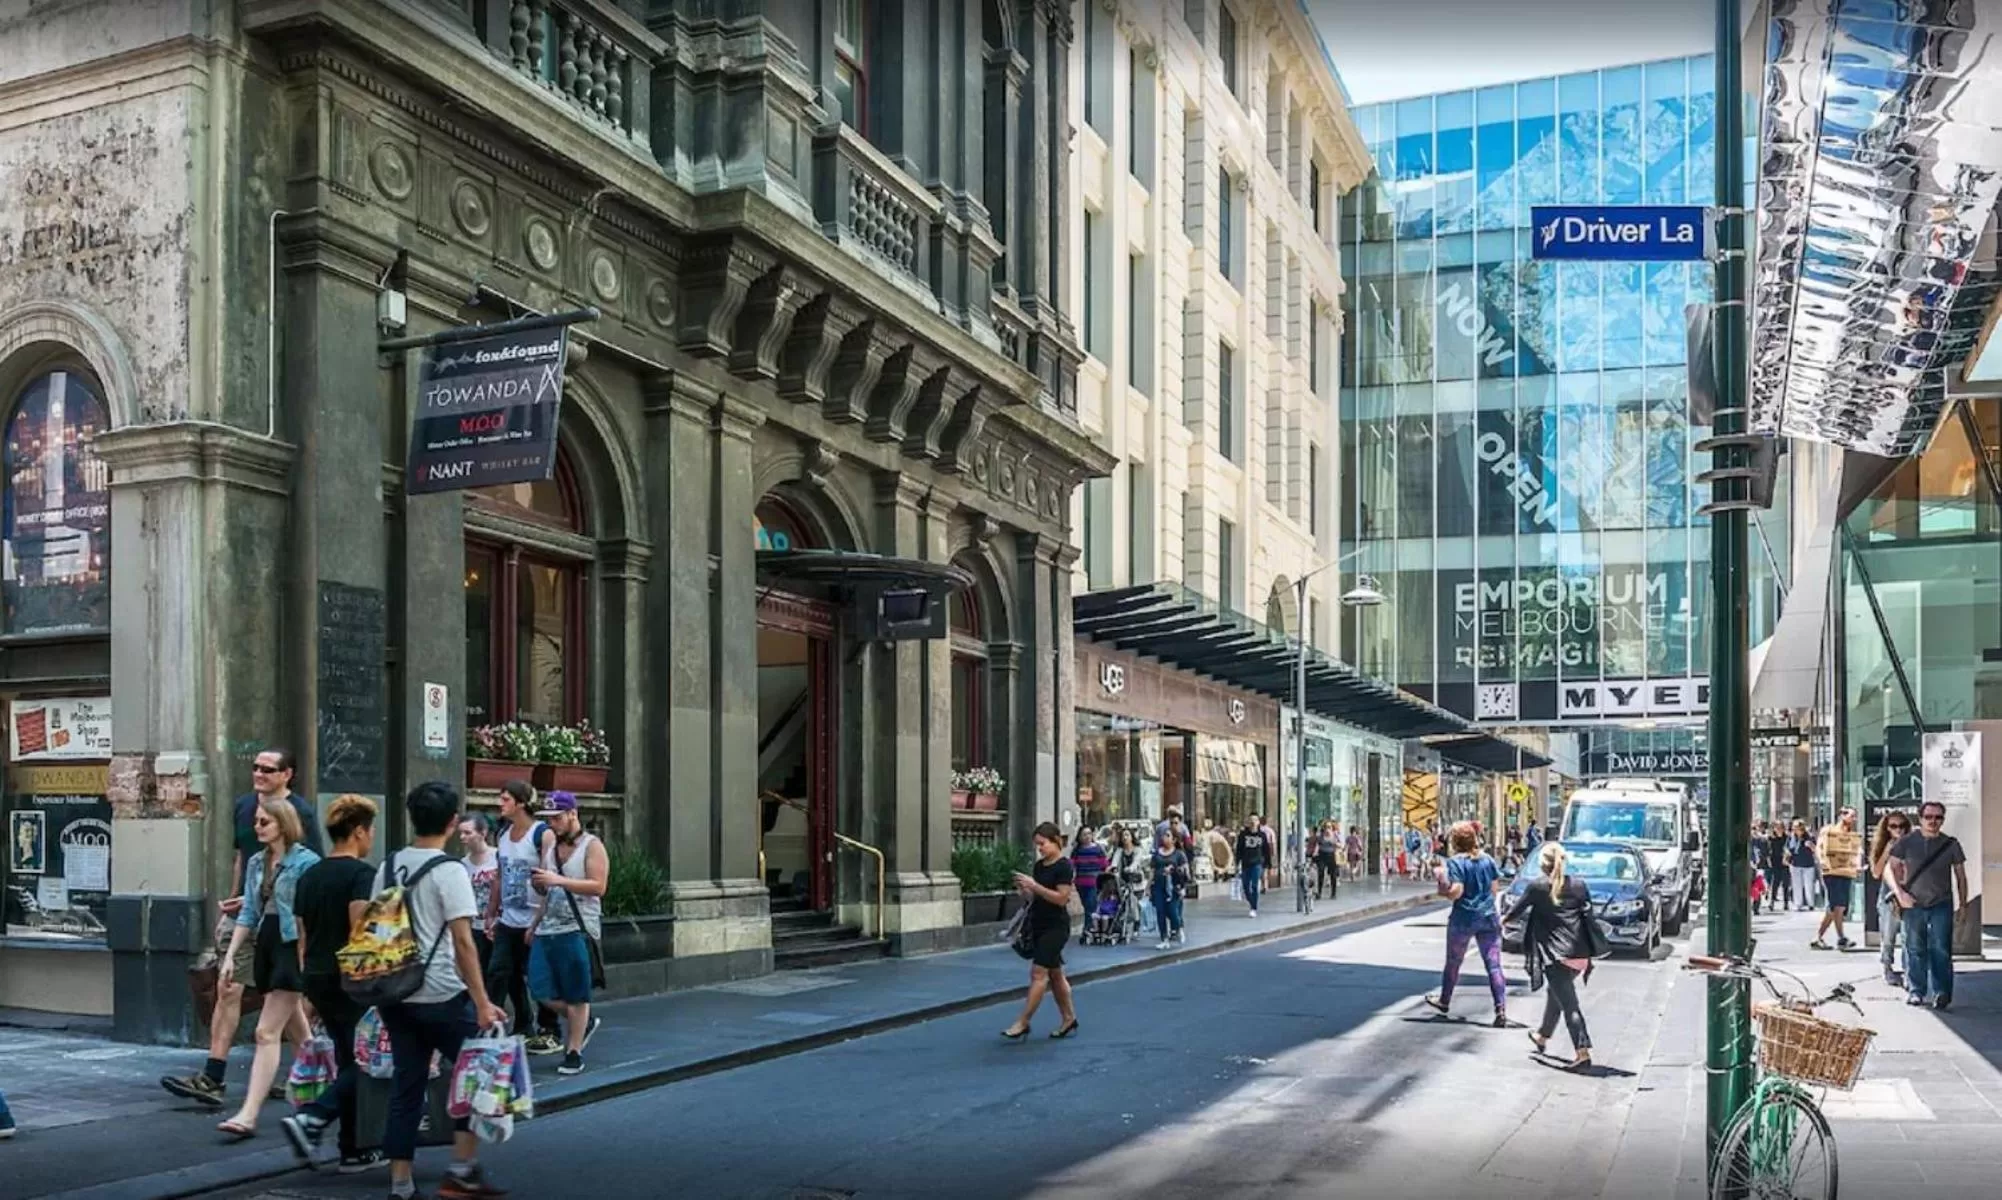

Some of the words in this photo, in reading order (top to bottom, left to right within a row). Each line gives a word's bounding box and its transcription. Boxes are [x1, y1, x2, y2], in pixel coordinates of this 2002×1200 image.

[1564, 217, 1651, 243] Driver
[1660, 217, 1694, 243] La
[1437, 282, 1514, 367] NOW
[474, 340, 560, 364] fox&found
[426, 378, 532, 408] TOWANDA
[459, 413, 506, 434] MOO
[428, 461, 474, 480] NANT
[1477, 432, 1559, 525] OPEN
[1455, 572, 1667, 612] EMPORIUM
[1455, 604, 1667, 639] MELBOURNE
[1101, 662, 1124, 694] UGG
[1229, 699, 1245, 724] UGG
[1750, 735, 1799, 746] MYER
[1606, 753, 1657, 769] DAVID
